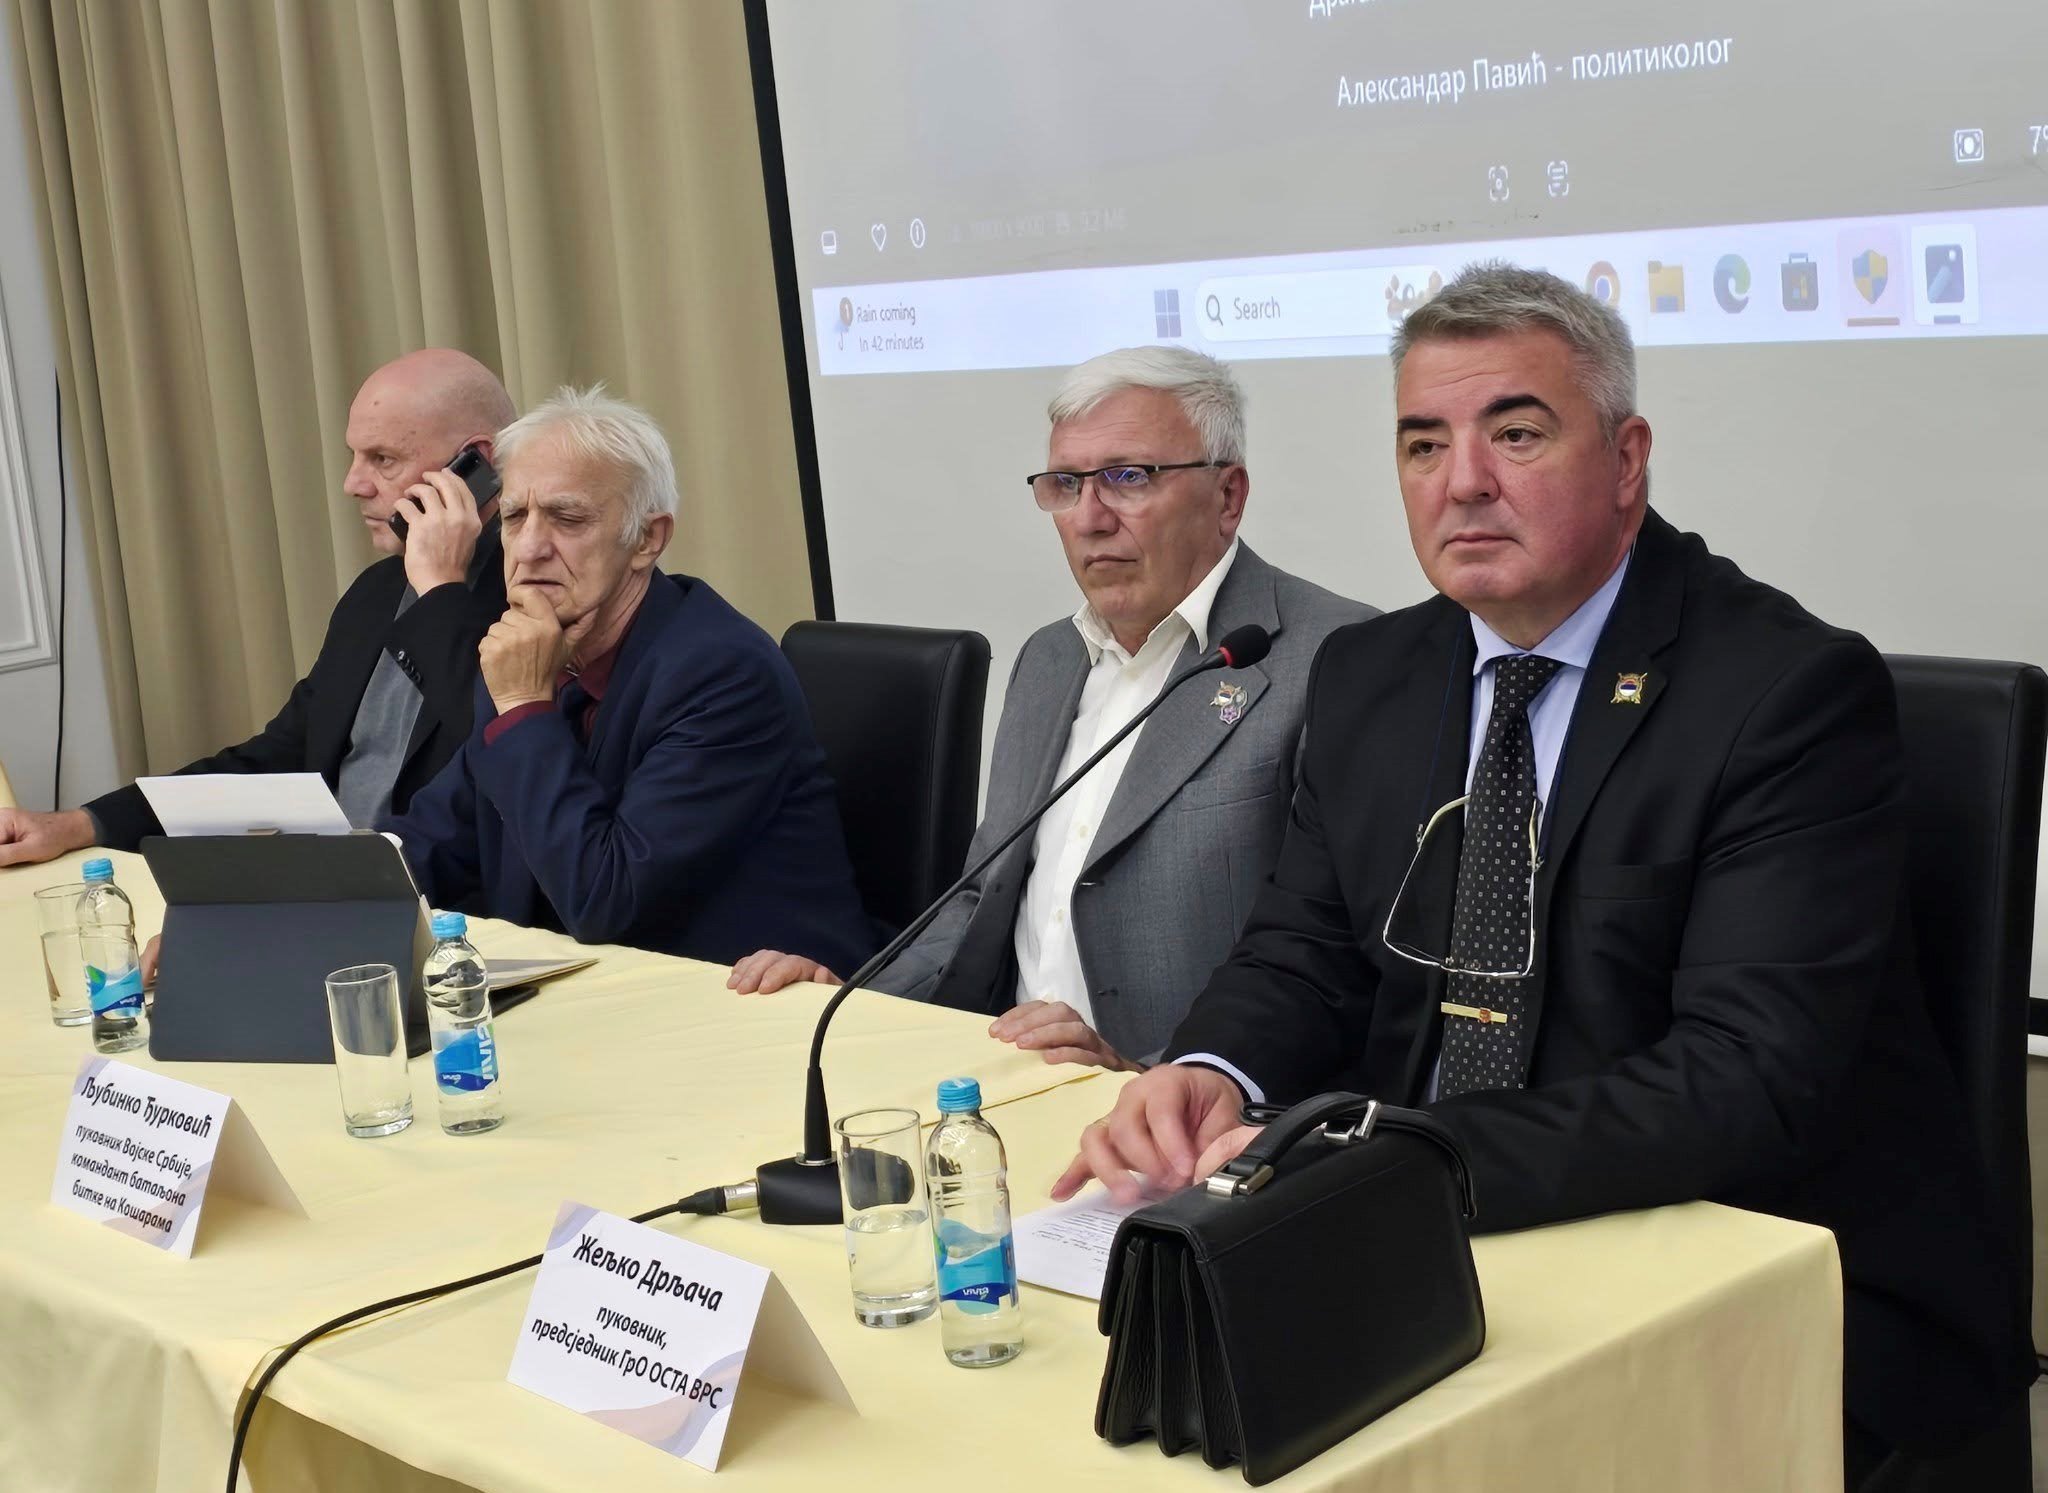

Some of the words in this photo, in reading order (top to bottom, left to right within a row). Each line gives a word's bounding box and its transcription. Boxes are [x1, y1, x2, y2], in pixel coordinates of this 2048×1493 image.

[1338, 69, 1466, 106] Александар
[1474, 51, 1546, 91] Павић
[1572, 37, 1733, 80] политиколог
[2030, 125, 2048, 155] 7
[857, 304, 877, 322] Rain
[880, 302, 916, 326] coming
[1234, 297, 1281, 321] Search
[872, 335, 883, 351] 42
[886, 332, 925, 350] minutes
[81, 1077, 141, 1114] Љубинко
[143, 1096, 212, 1138] Ђурковић
[76, 1125, 122, 1151] пуковник
[122, 1138, 155, 1163] Војске
[156, 1150, 192, 1180] Србије,
[71, 1153, 128, 1184] командант
[129, 1171, 186, 1206] батаљона
[72, 1179, 104, 1206] битке
[103, 1195, 116, 1211] на
[117, 1197, 173, 1233] Кошарама
[572, 1233, 640, 1280] Жељко
[637, 1259, 723, 1311] Дрљача
[596, 1306, 667, 1350] пуковник,
[531, 1318, 620, 1366] предсједник
[619, 1349, 648, 1377] ГрО
[649, 1362, 688, 1396] ОСТА
[688, 1378, 723, 1409] ВРС
